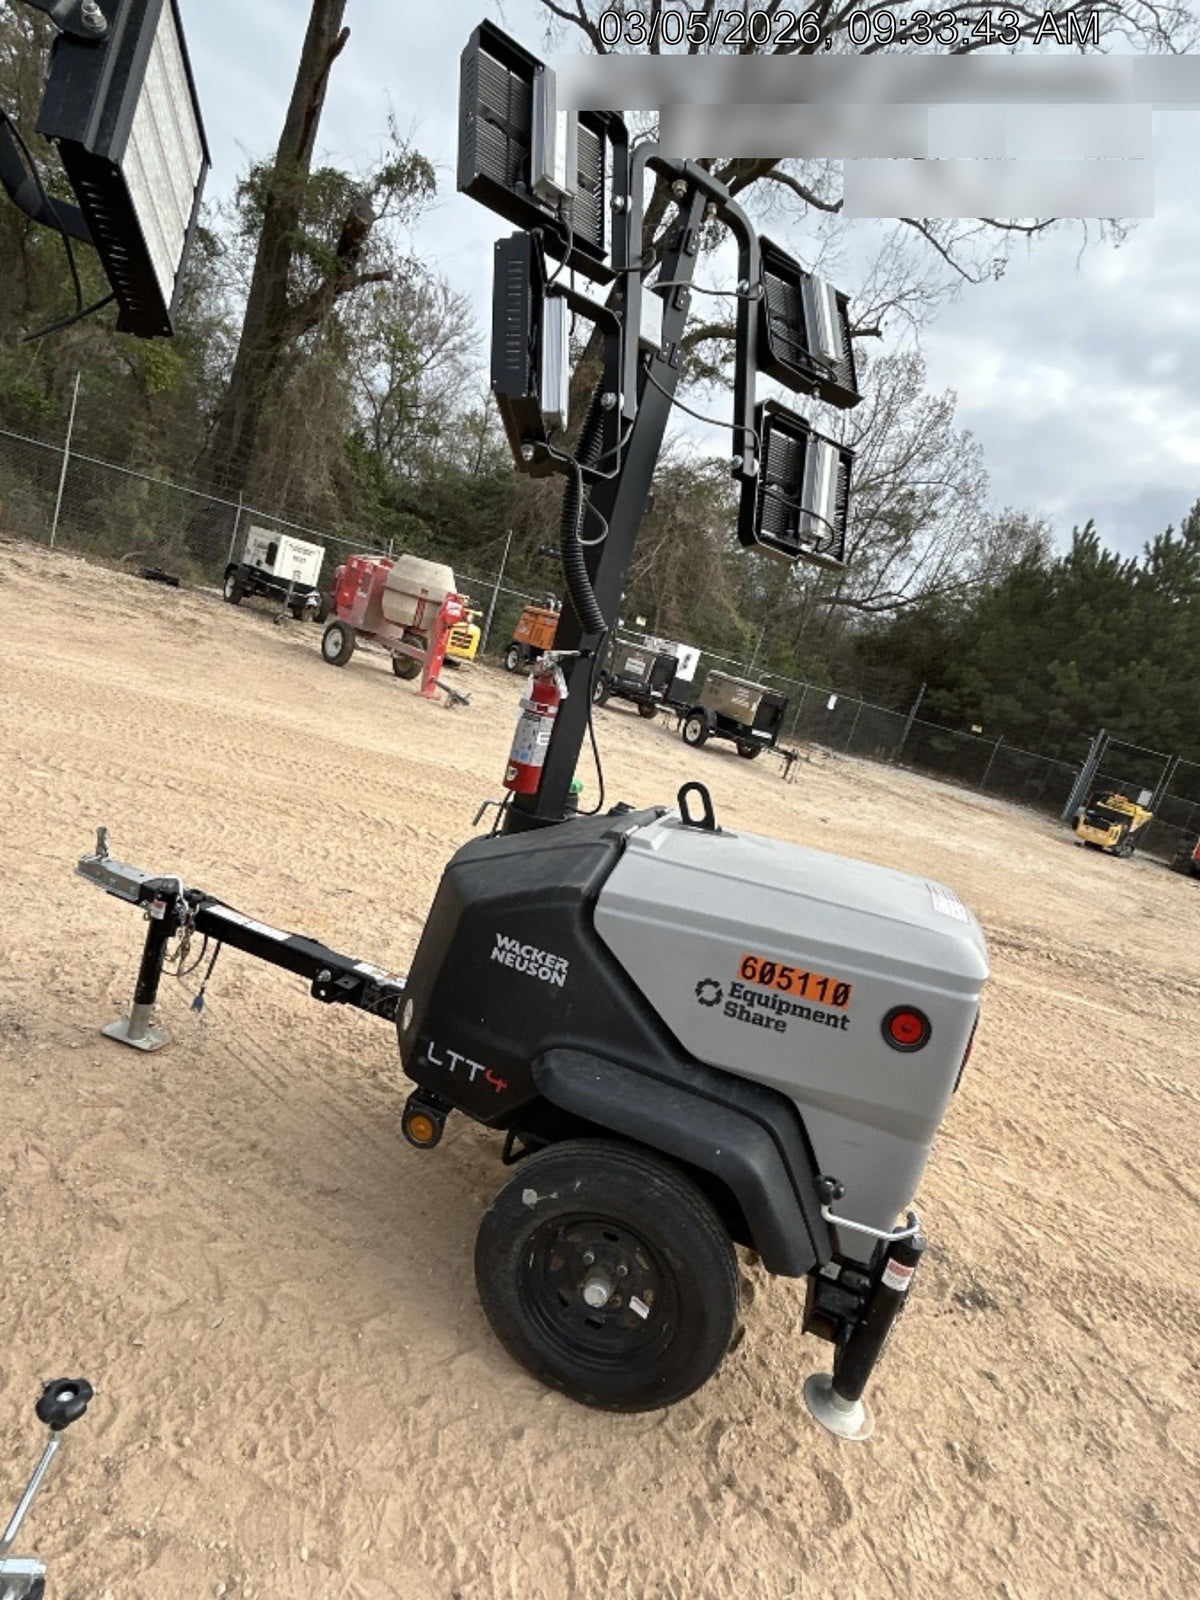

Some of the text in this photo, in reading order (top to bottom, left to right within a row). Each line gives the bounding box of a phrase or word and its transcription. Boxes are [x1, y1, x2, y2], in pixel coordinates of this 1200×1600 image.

[490, 947, 567, 987] NEUSON
[496, 932, 569, 975] WACKER
[740, 956, 852, 1007] 605110
[723, 1001, 788, 1033] Share
[728, 981, 851, 1031] Equipment
[428, 1041, 507, 1093] LTT4
